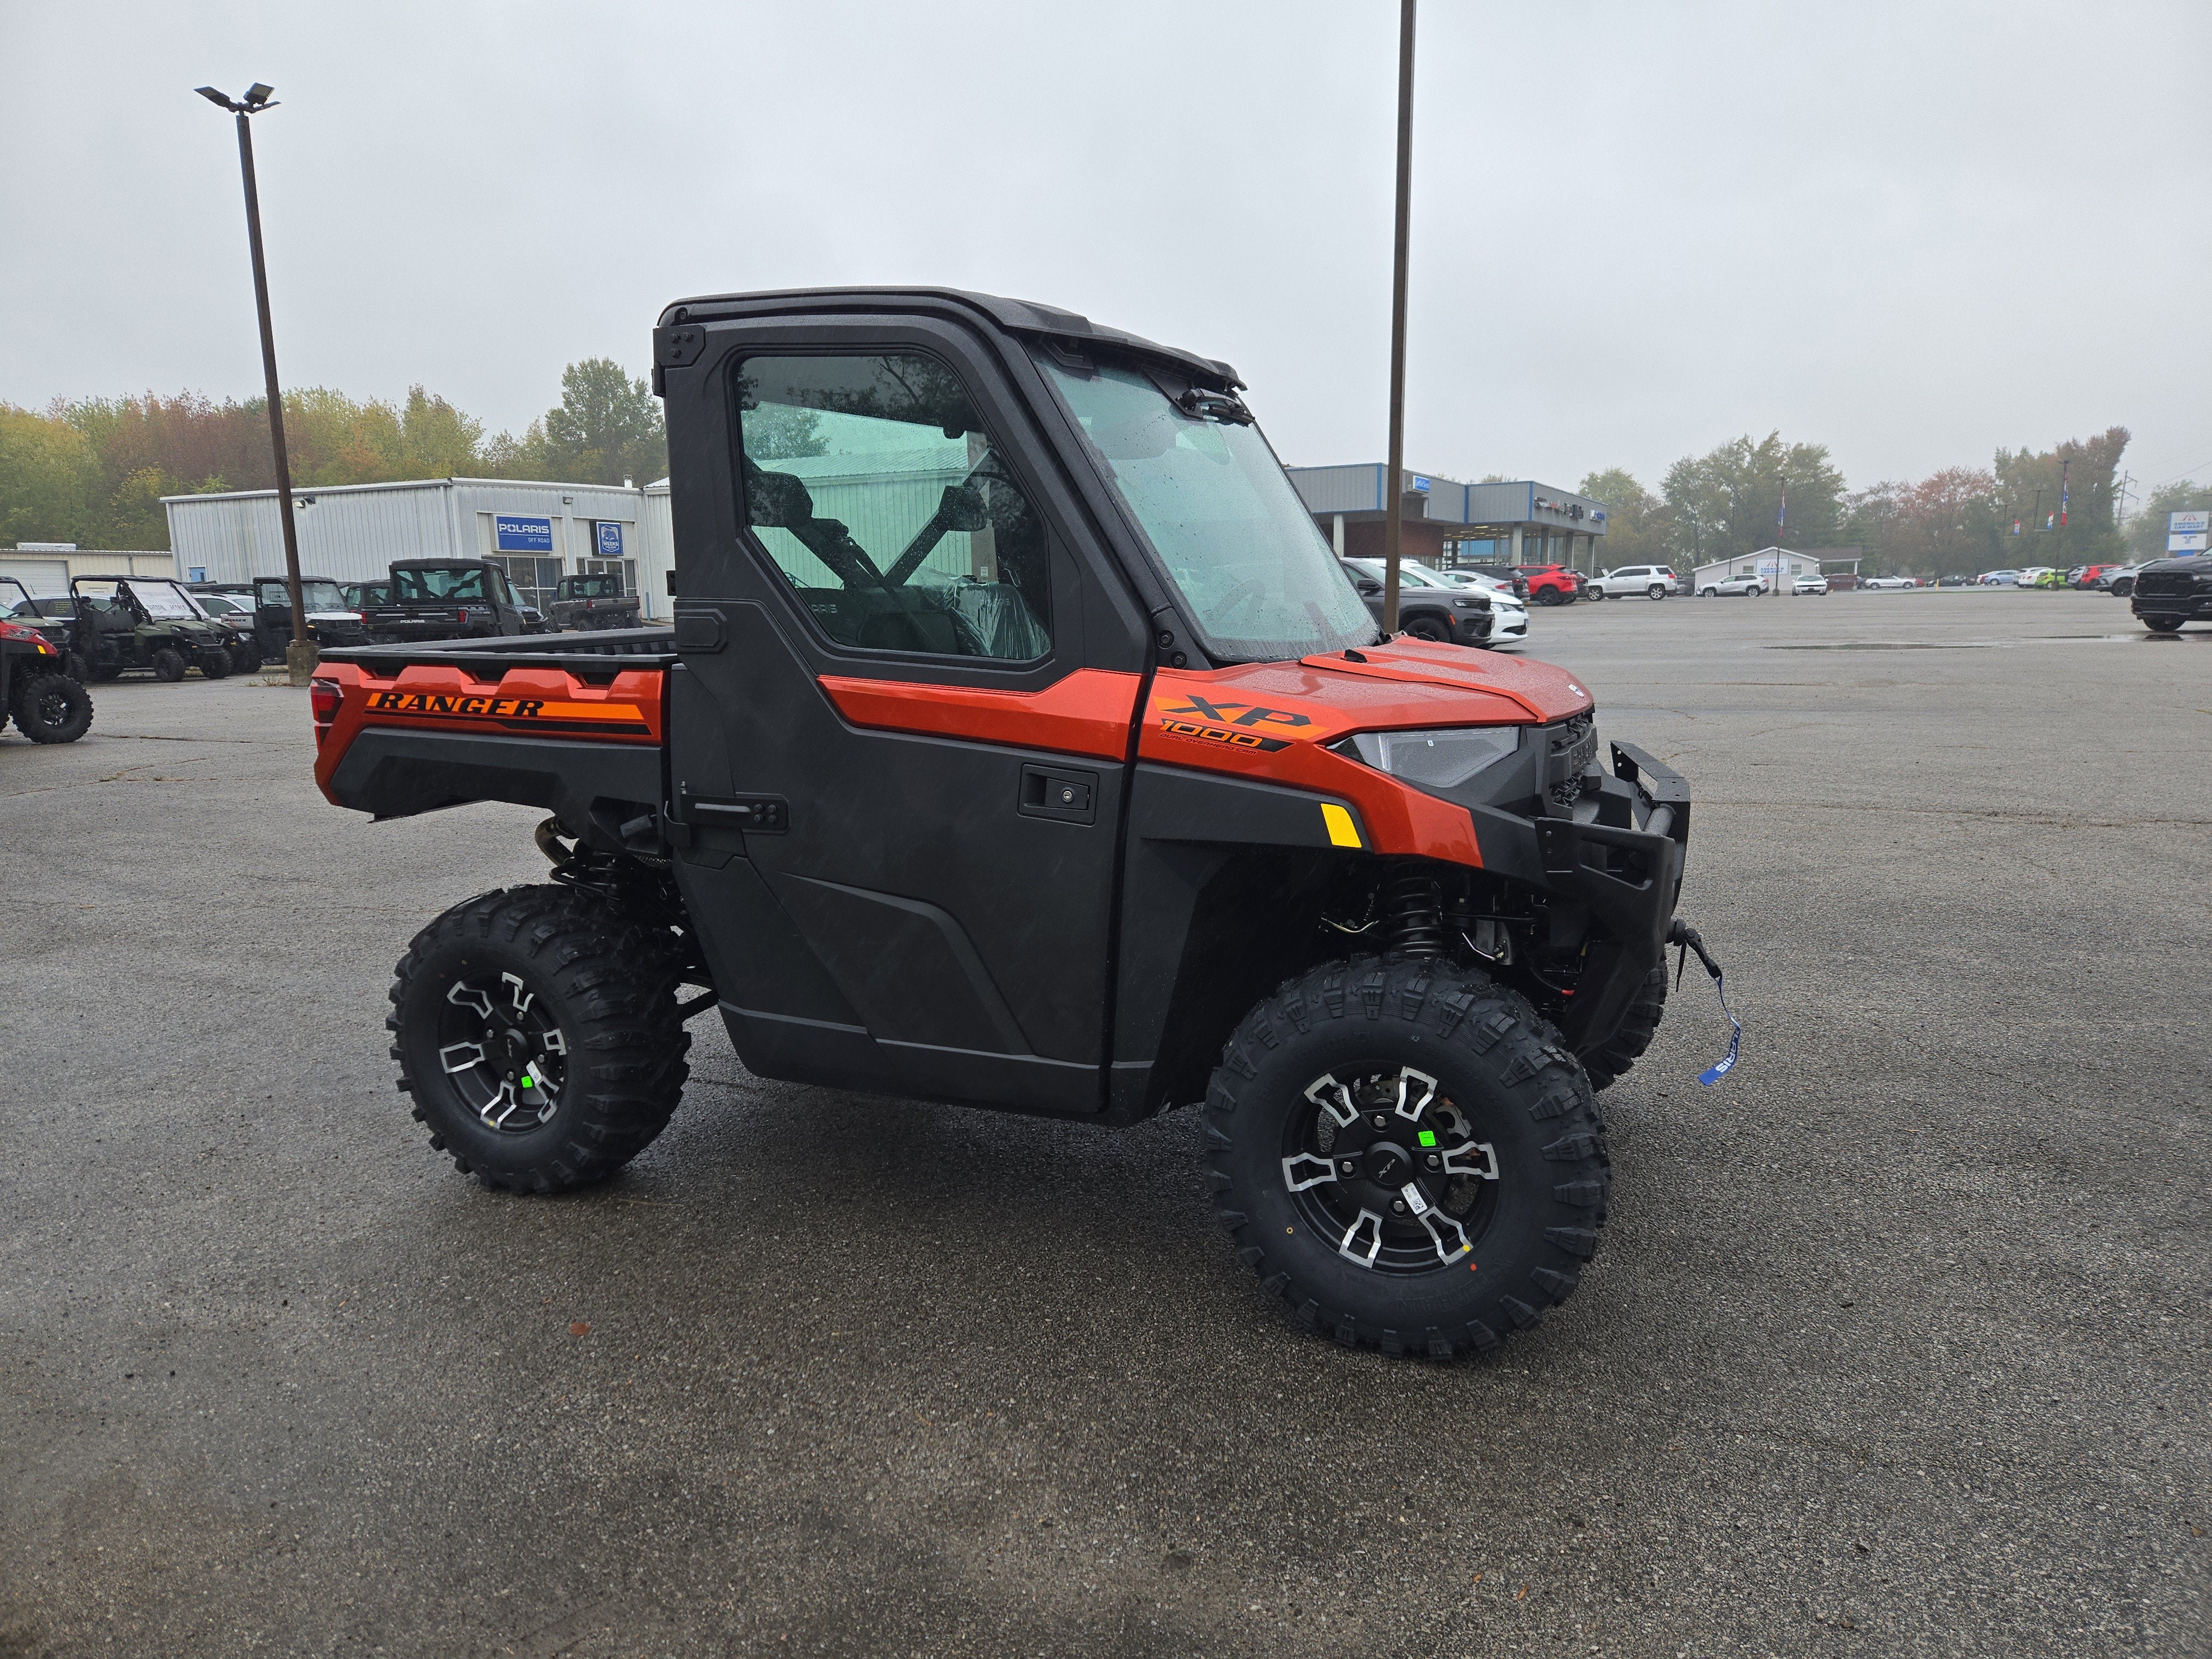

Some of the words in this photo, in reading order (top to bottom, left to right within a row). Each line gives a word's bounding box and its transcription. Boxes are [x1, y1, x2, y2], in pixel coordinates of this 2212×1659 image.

[499, 523, 549, 533] POLARIS
[811, 604, 838, 613] ARIS
[375, 692, 544, 717] RANGER
[1161, 695, 1312, 727] XP
[1160, 721, 1263, 747] 1000
[1160, 733, 1183, 741] DUAL
[1185, 737, 1235, 750] OVERHEAD
[1715, 1030, 1740, 1073] LARIS
[1378, 1159, 1396, 1178] XP
